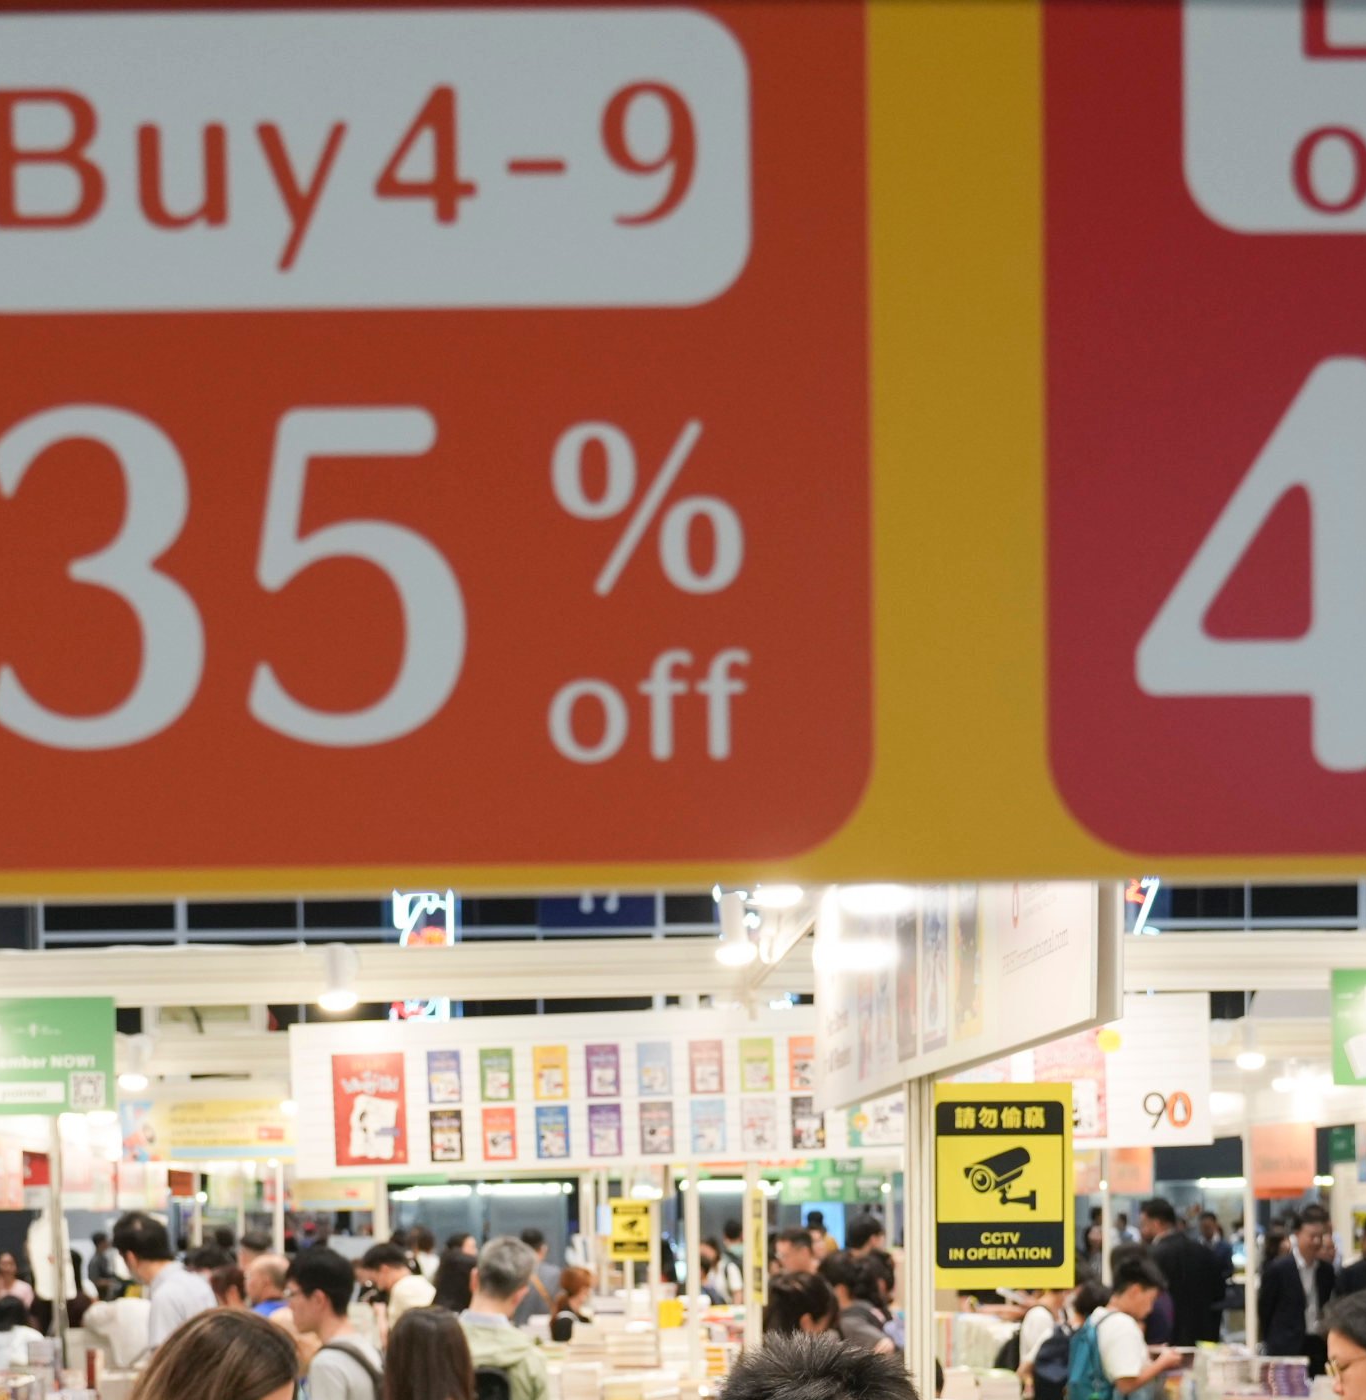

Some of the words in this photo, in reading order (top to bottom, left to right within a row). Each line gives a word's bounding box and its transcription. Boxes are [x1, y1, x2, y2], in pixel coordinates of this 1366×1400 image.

[546, 648, 751, 765] off
[51, 1055, 96, 1069] NOW!
[981, 1232, 1020, 1245] CCTV
[949, 1248, 964, 1260] IN
[967, 1247, 1051, 1260] OPERATION
